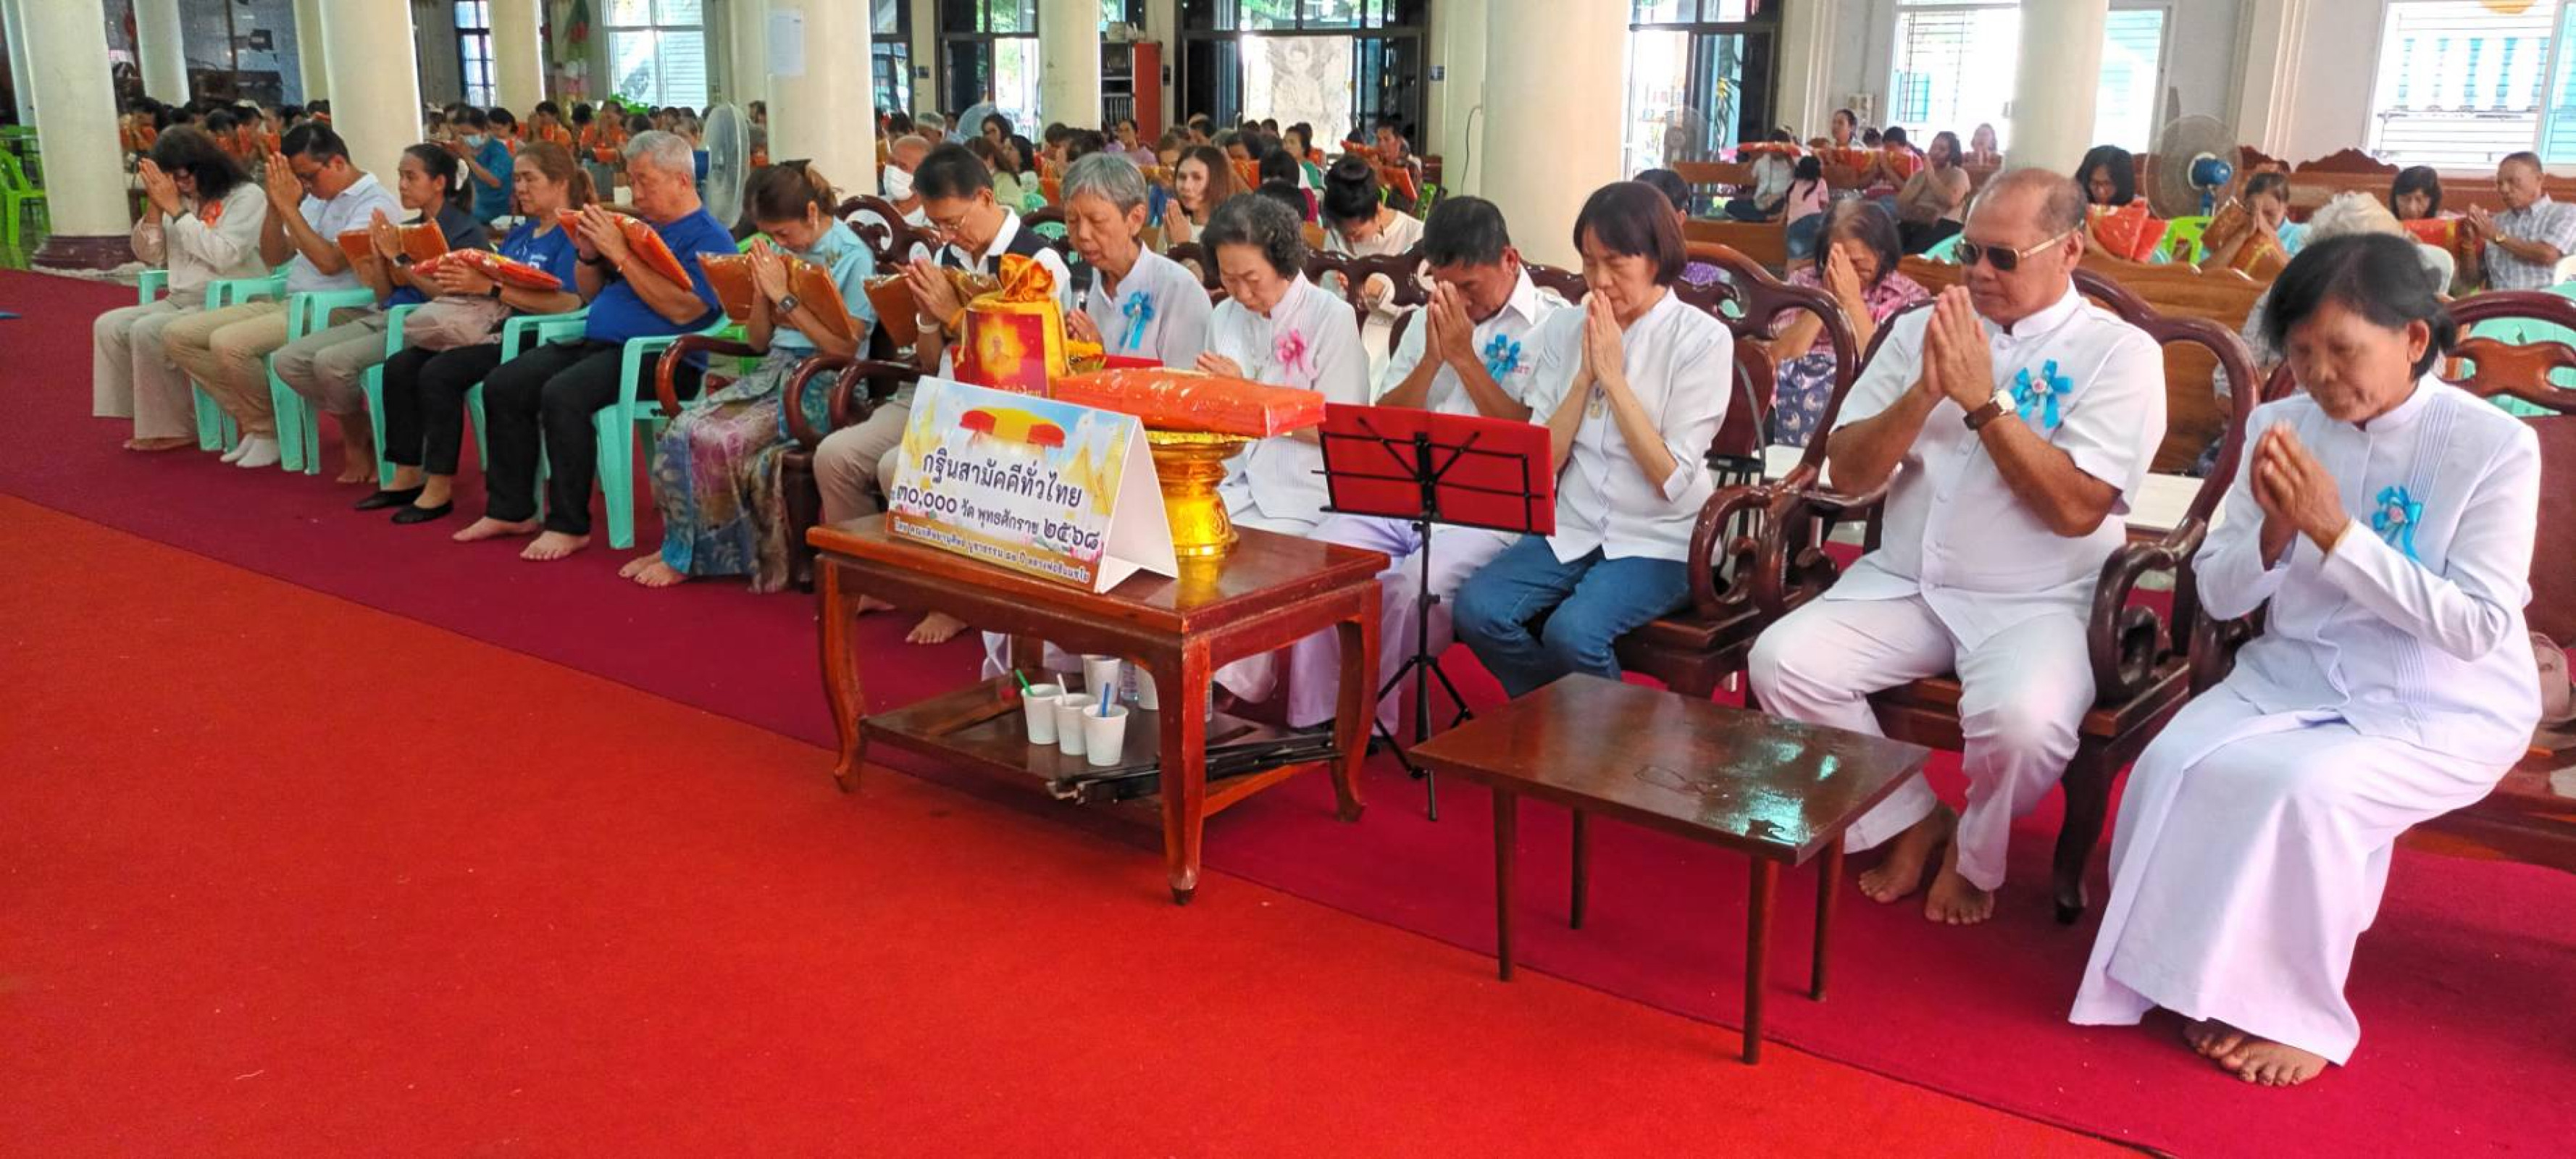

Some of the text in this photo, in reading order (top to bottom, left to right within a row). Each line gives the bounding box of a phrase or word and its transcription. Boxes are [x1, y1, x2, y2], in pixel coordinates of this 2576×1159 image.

[923, 448, 1082, 508] กฐินสามัคคีทั่วไทย
[897, 485, 1100, 551] ๓๐,๐๐๐ วัด พุทธศักราช ๒๕๖๘
